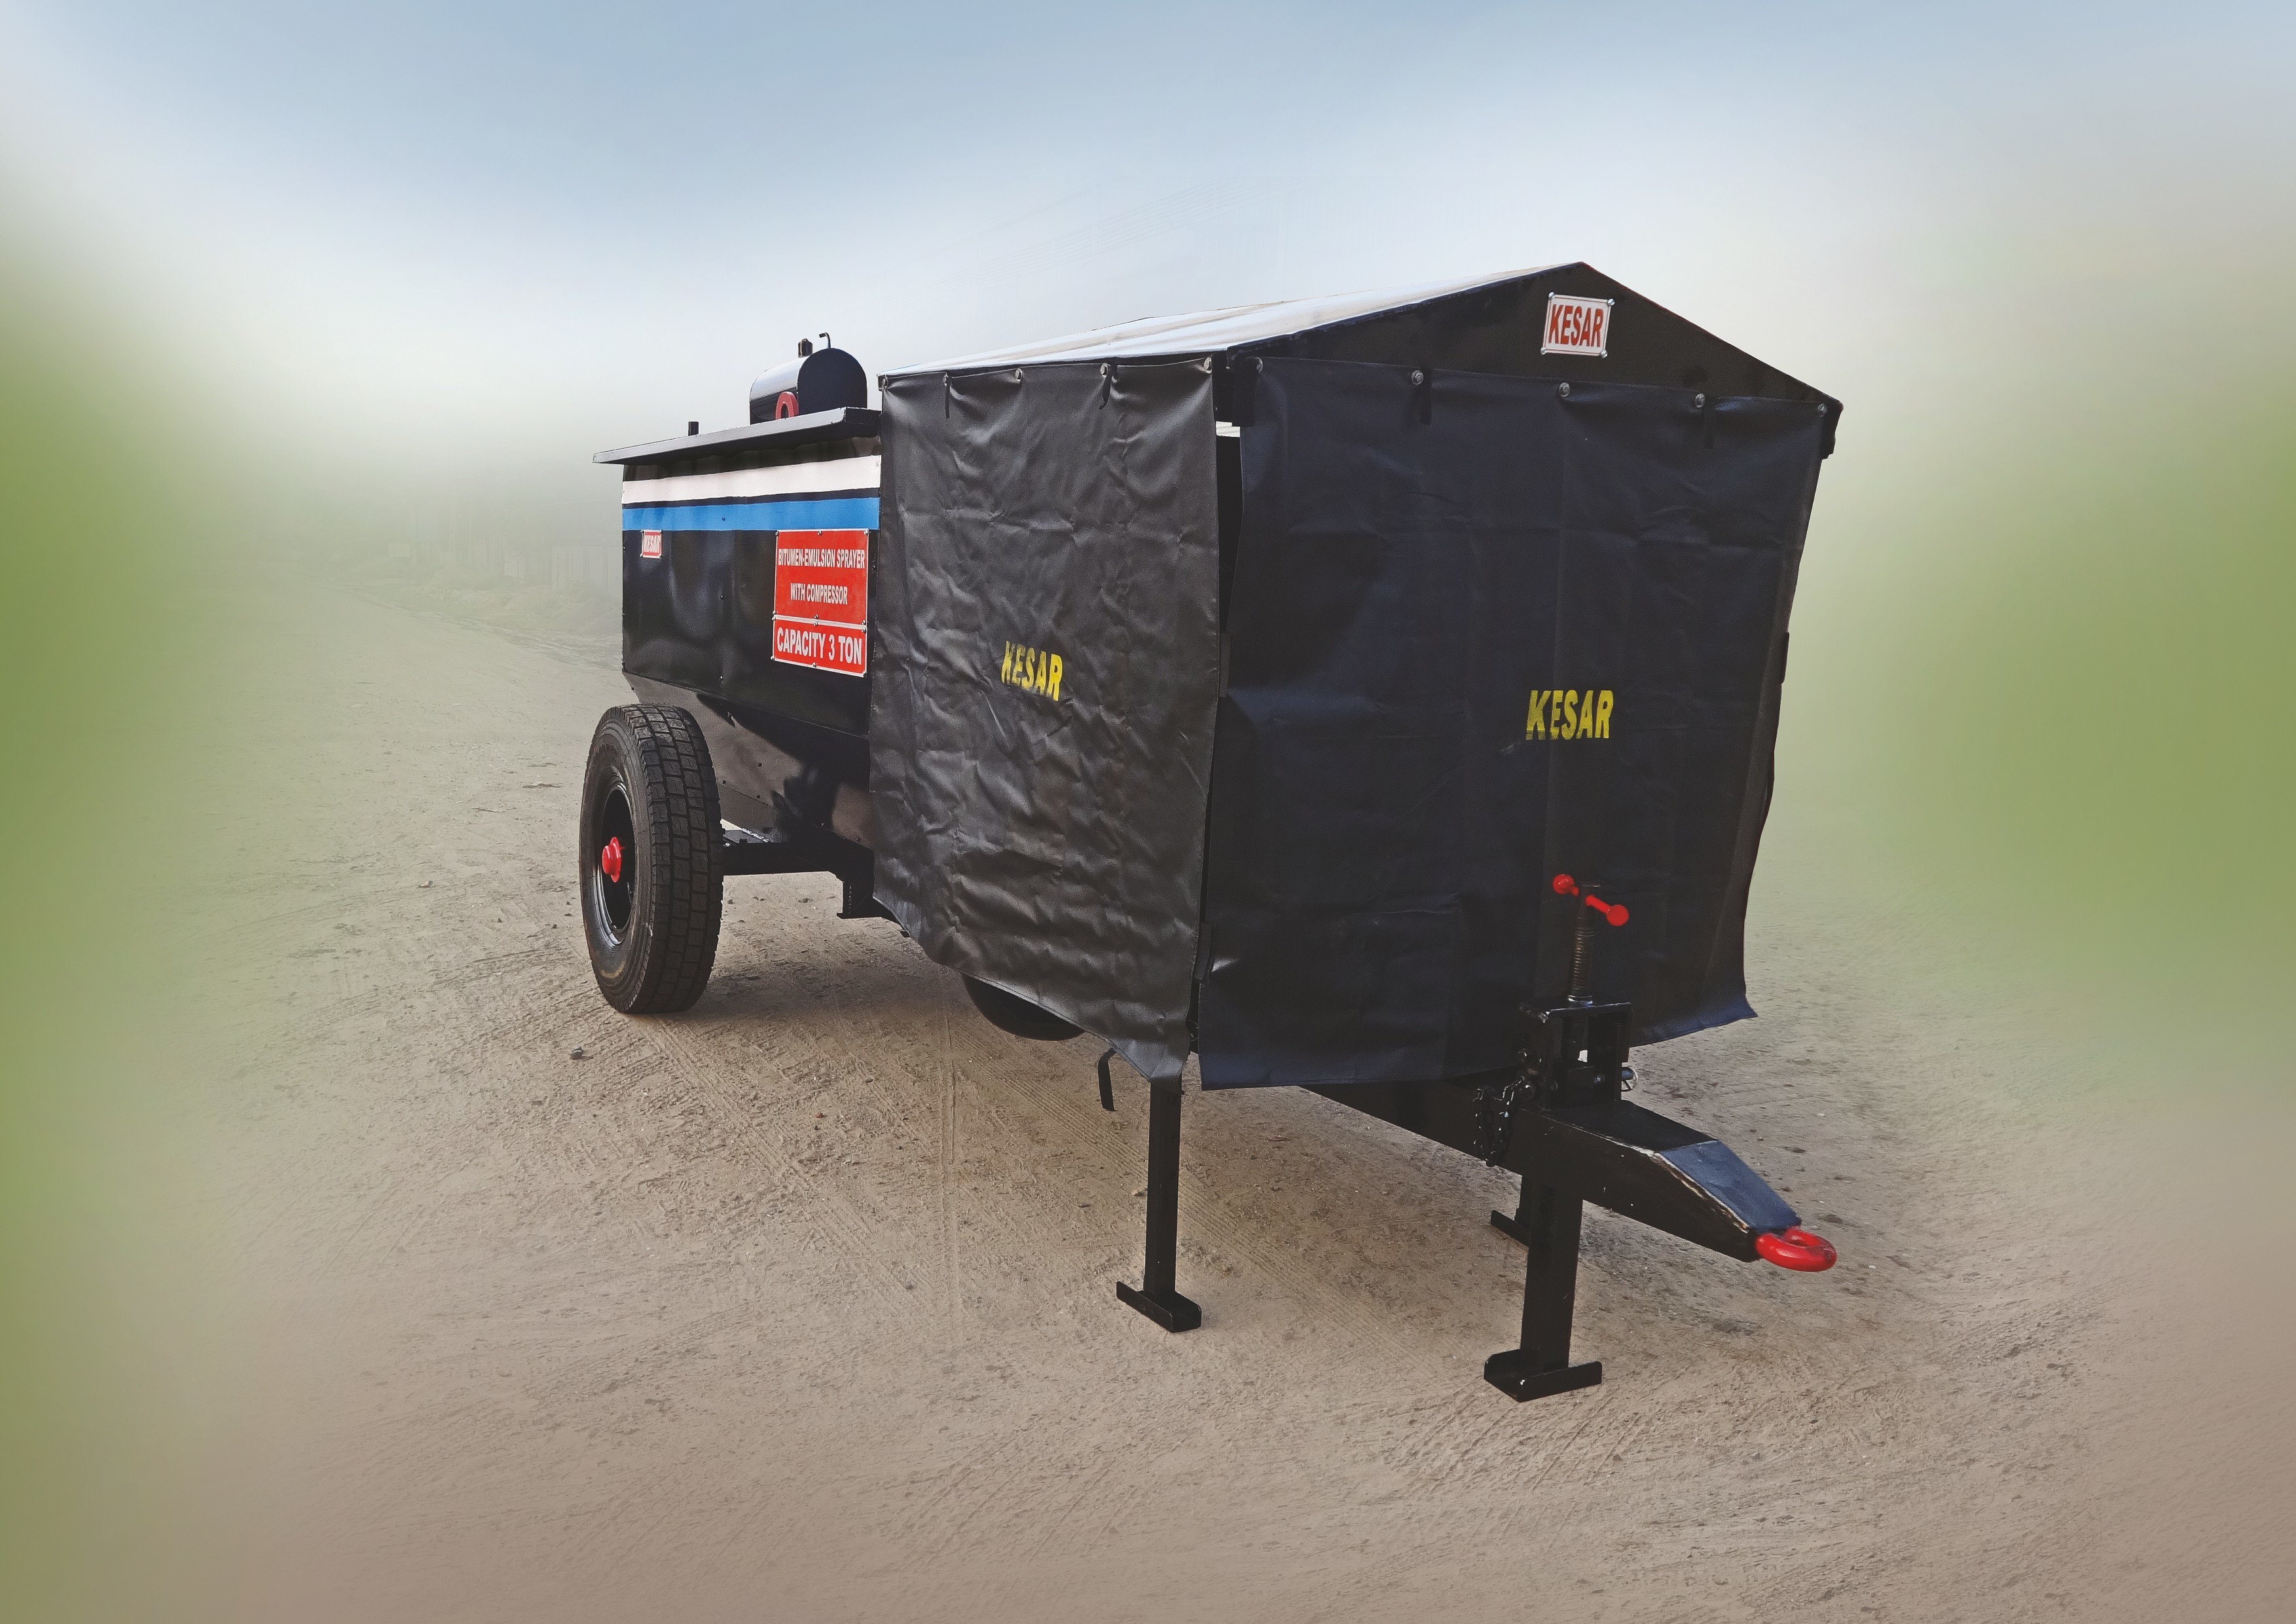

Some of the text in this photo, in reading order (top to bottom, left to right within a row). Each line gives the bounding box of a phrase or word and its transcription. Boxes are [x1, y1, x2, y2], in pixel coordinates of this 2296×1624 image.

[1548, 303, 1604, 347] KESAR
[778, 548, 866, 569] BITUMEN-EMULSION SPRAYER
[790, 583, 848, 605] WITH COMPRESSOR
[776, 627, 862, 665] CAPACITY 3 TON
[1001, 640, 1063, 701] KESAR
[1525, 690, 1614, 740] KESAR
